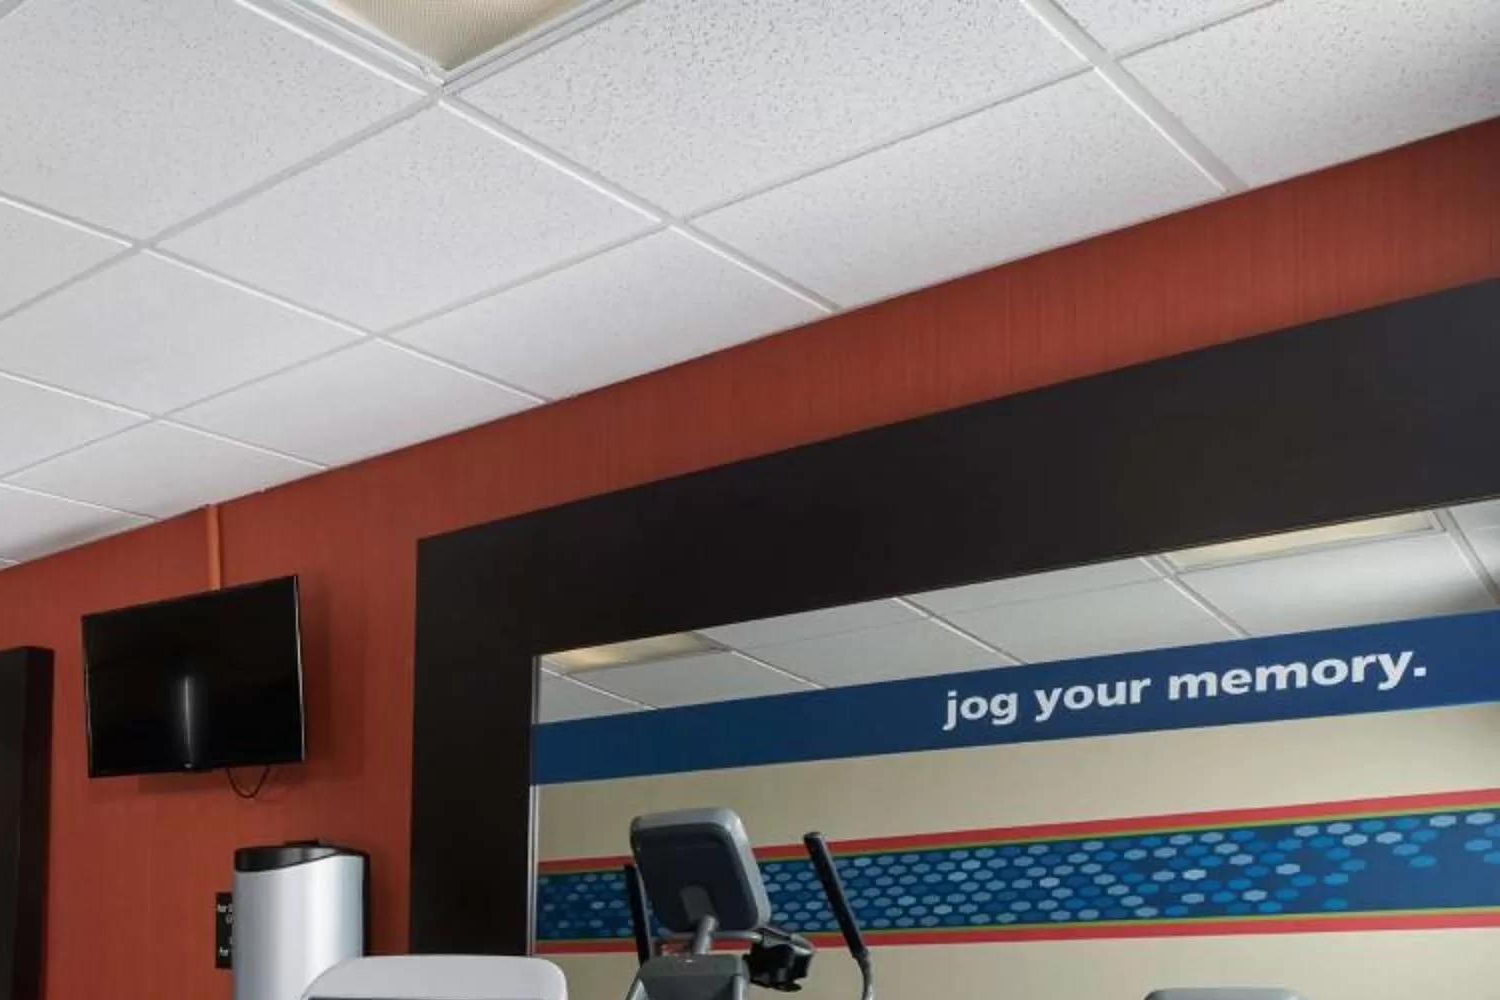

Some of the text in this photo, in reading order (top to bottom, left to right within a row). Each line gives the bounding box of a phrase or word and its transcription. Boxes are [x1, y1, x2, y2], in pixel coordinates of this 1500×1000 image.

[942, 650, 1428, 731] jog your memory.
